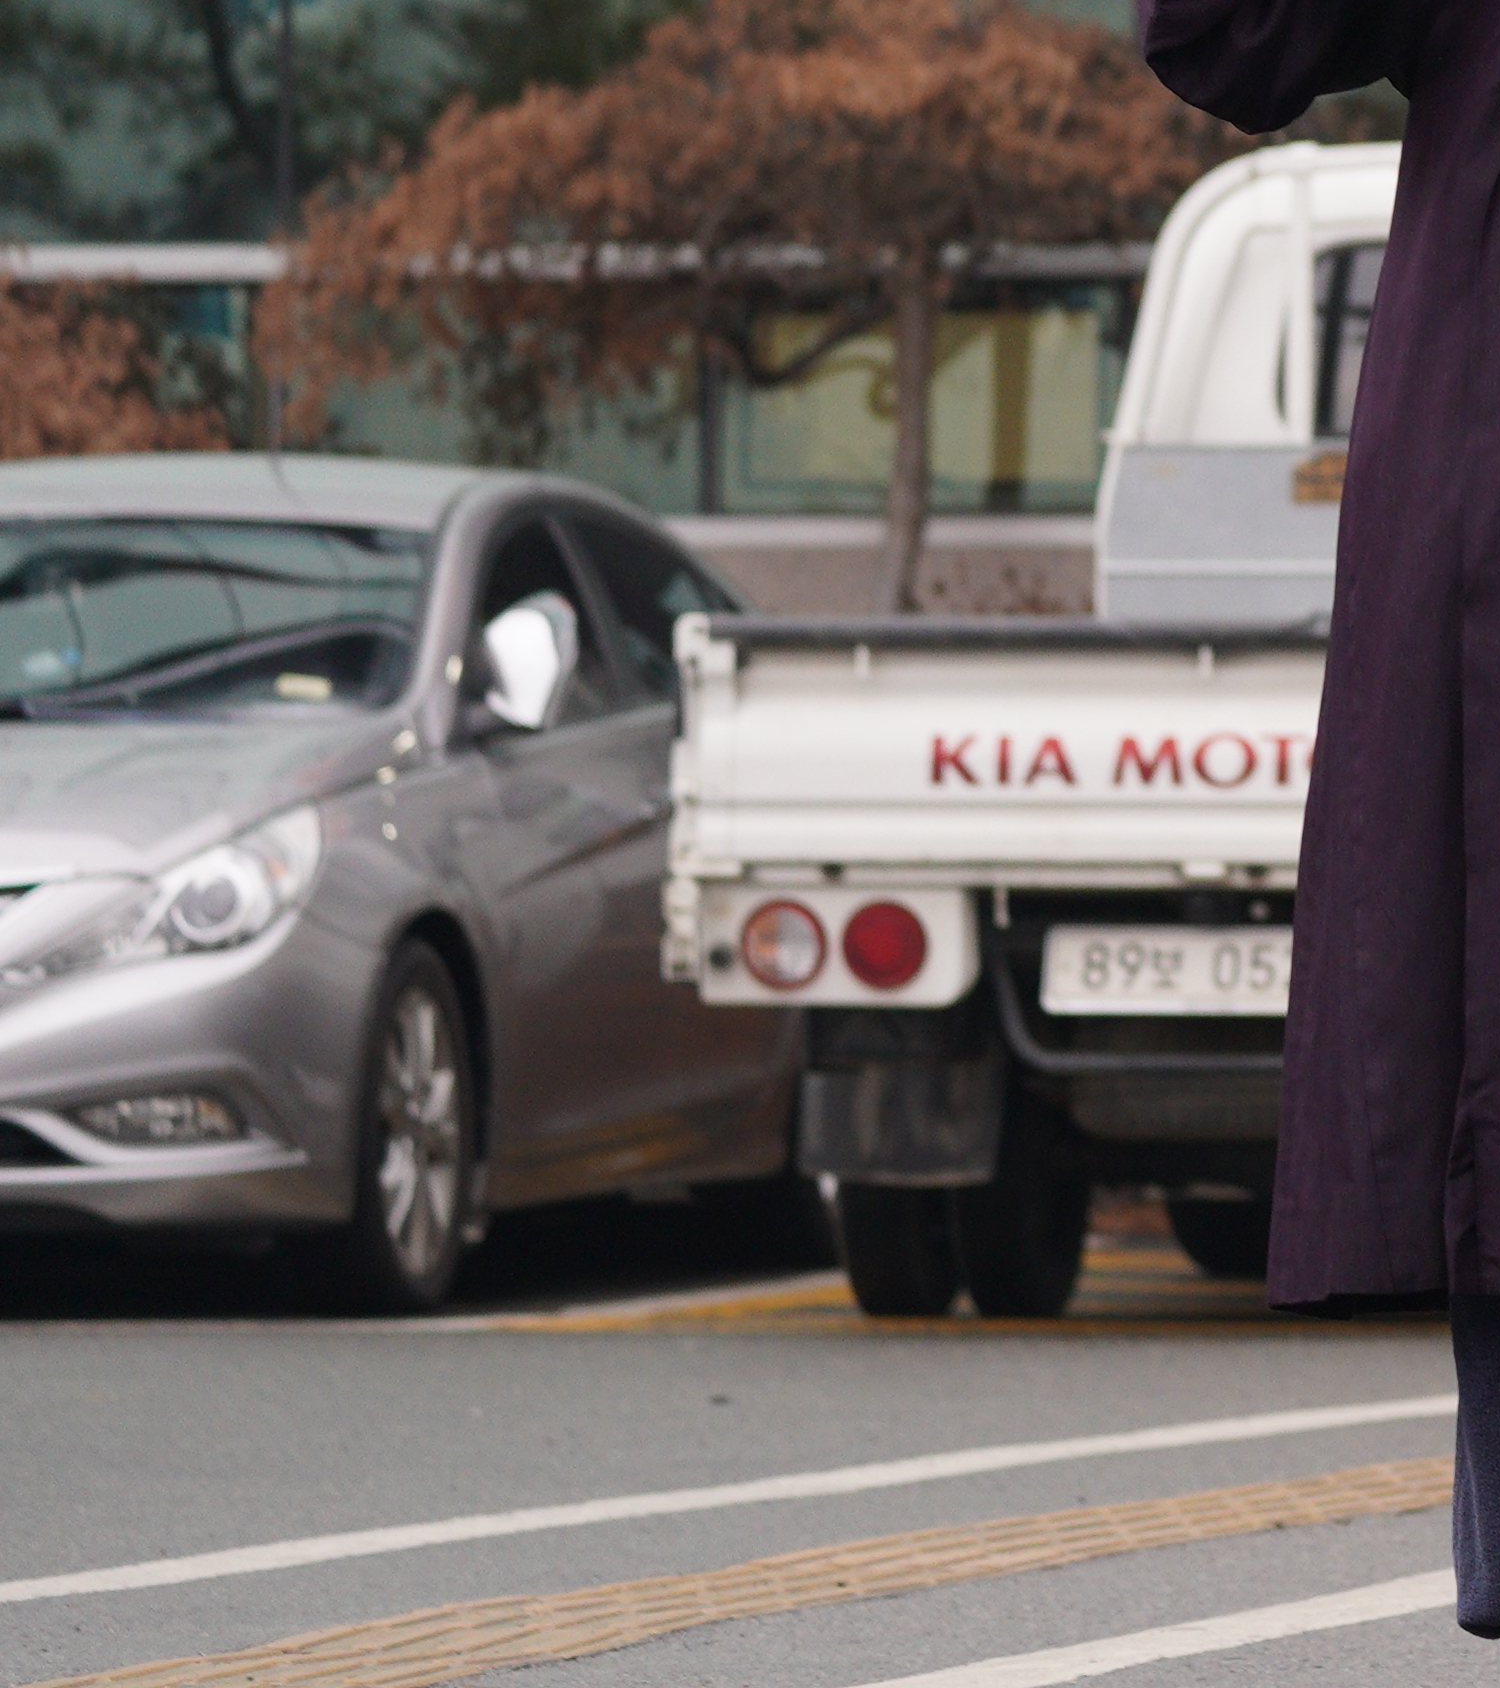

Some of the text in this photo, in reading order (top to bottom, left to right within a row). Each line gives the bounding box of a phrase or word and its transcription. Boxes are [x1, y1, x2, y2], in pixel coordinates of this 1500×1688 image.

[930, 732, 1318, 788] KIA MOT
[1081, 939, 1292, 992] 89보 05
